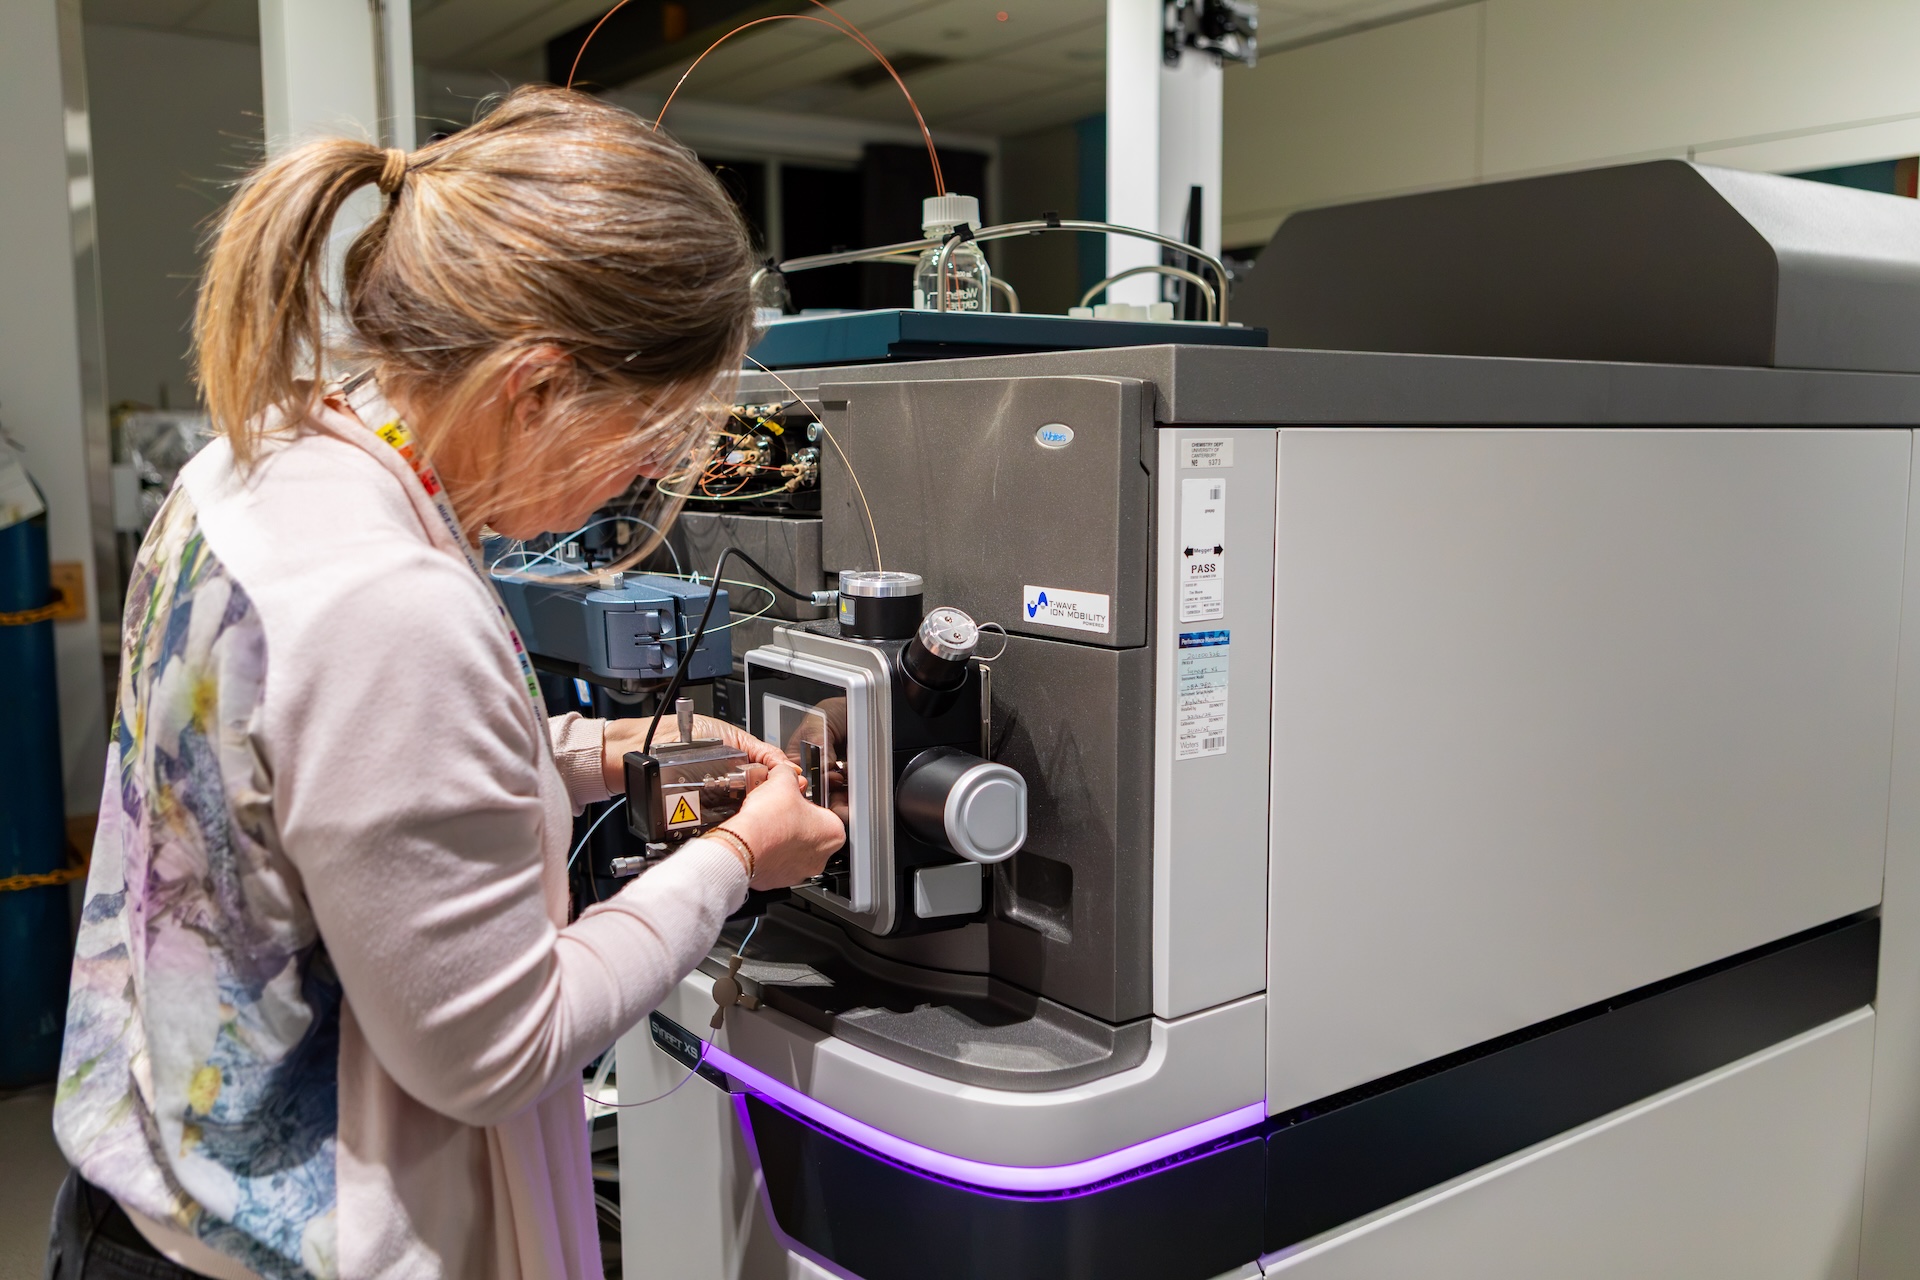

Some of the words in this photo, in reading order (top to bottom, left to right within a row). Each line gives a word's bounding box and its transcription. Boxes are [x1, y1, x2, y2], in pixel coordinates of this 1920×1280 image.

[384, 430, 397, 444] Pt
[1042, 430, 1066, 442] Waters
[1191, 563, 1216, 573] PASS
[1049, 600, 1076, 610] T-WAVE
[1067, 611, 1106, 622] MOBILITY
[683, 1042, 698, 1060] XS
